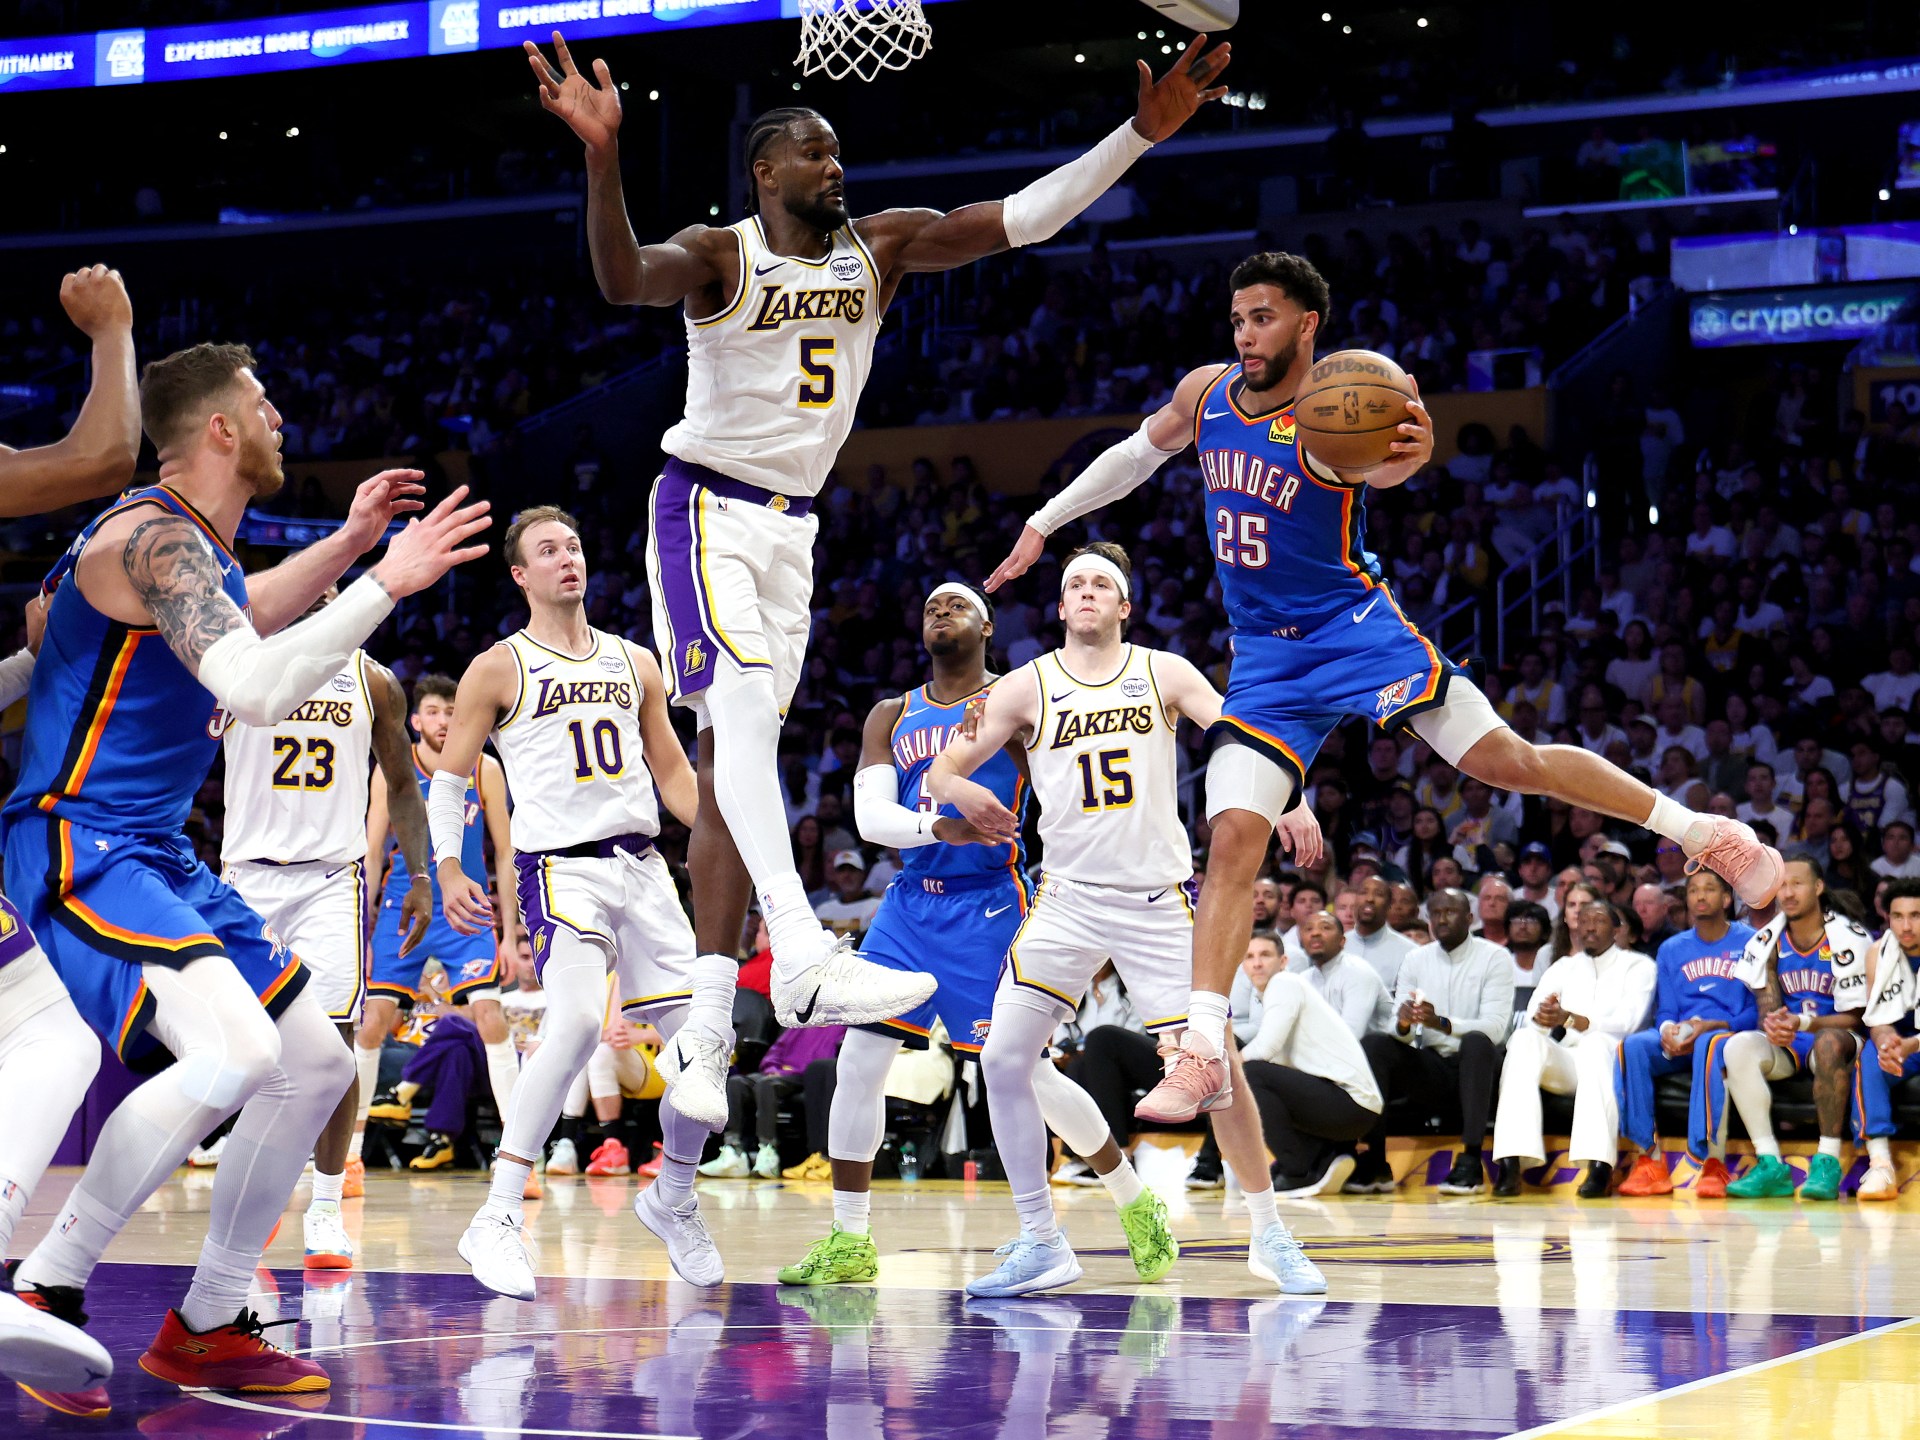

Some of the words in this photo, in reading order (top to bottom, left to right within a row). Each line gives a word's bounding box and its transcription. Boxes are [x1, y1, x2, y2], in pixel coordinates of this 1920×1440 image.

[498, 2, 602, 29] EXPERIENCE
[164, 35, 263, 63] EXPERIENCE
[264, 31, 310, 54] MORE
[832, 262, 860, 274] bibigo
[745, 283, 868, 333] LAKERS
[797, 335, 837, 409] 5
[1310, 357, 1393, 384] Wilson
[1199, 448, 1302, 514] THUNDER
[1215, 505, 1269, 570] 25
[531, 677, 632, 720] LAKERS
[1123, 683, 1147, 691] bibigo
[1050, 705, 1154, 750] LAKERS
[272, 735, 336, 792] 23
[568, 717, 626, 784] 10
[1077, 748, 1135, 813] 15
[922, 877, 945, 895] OKC
